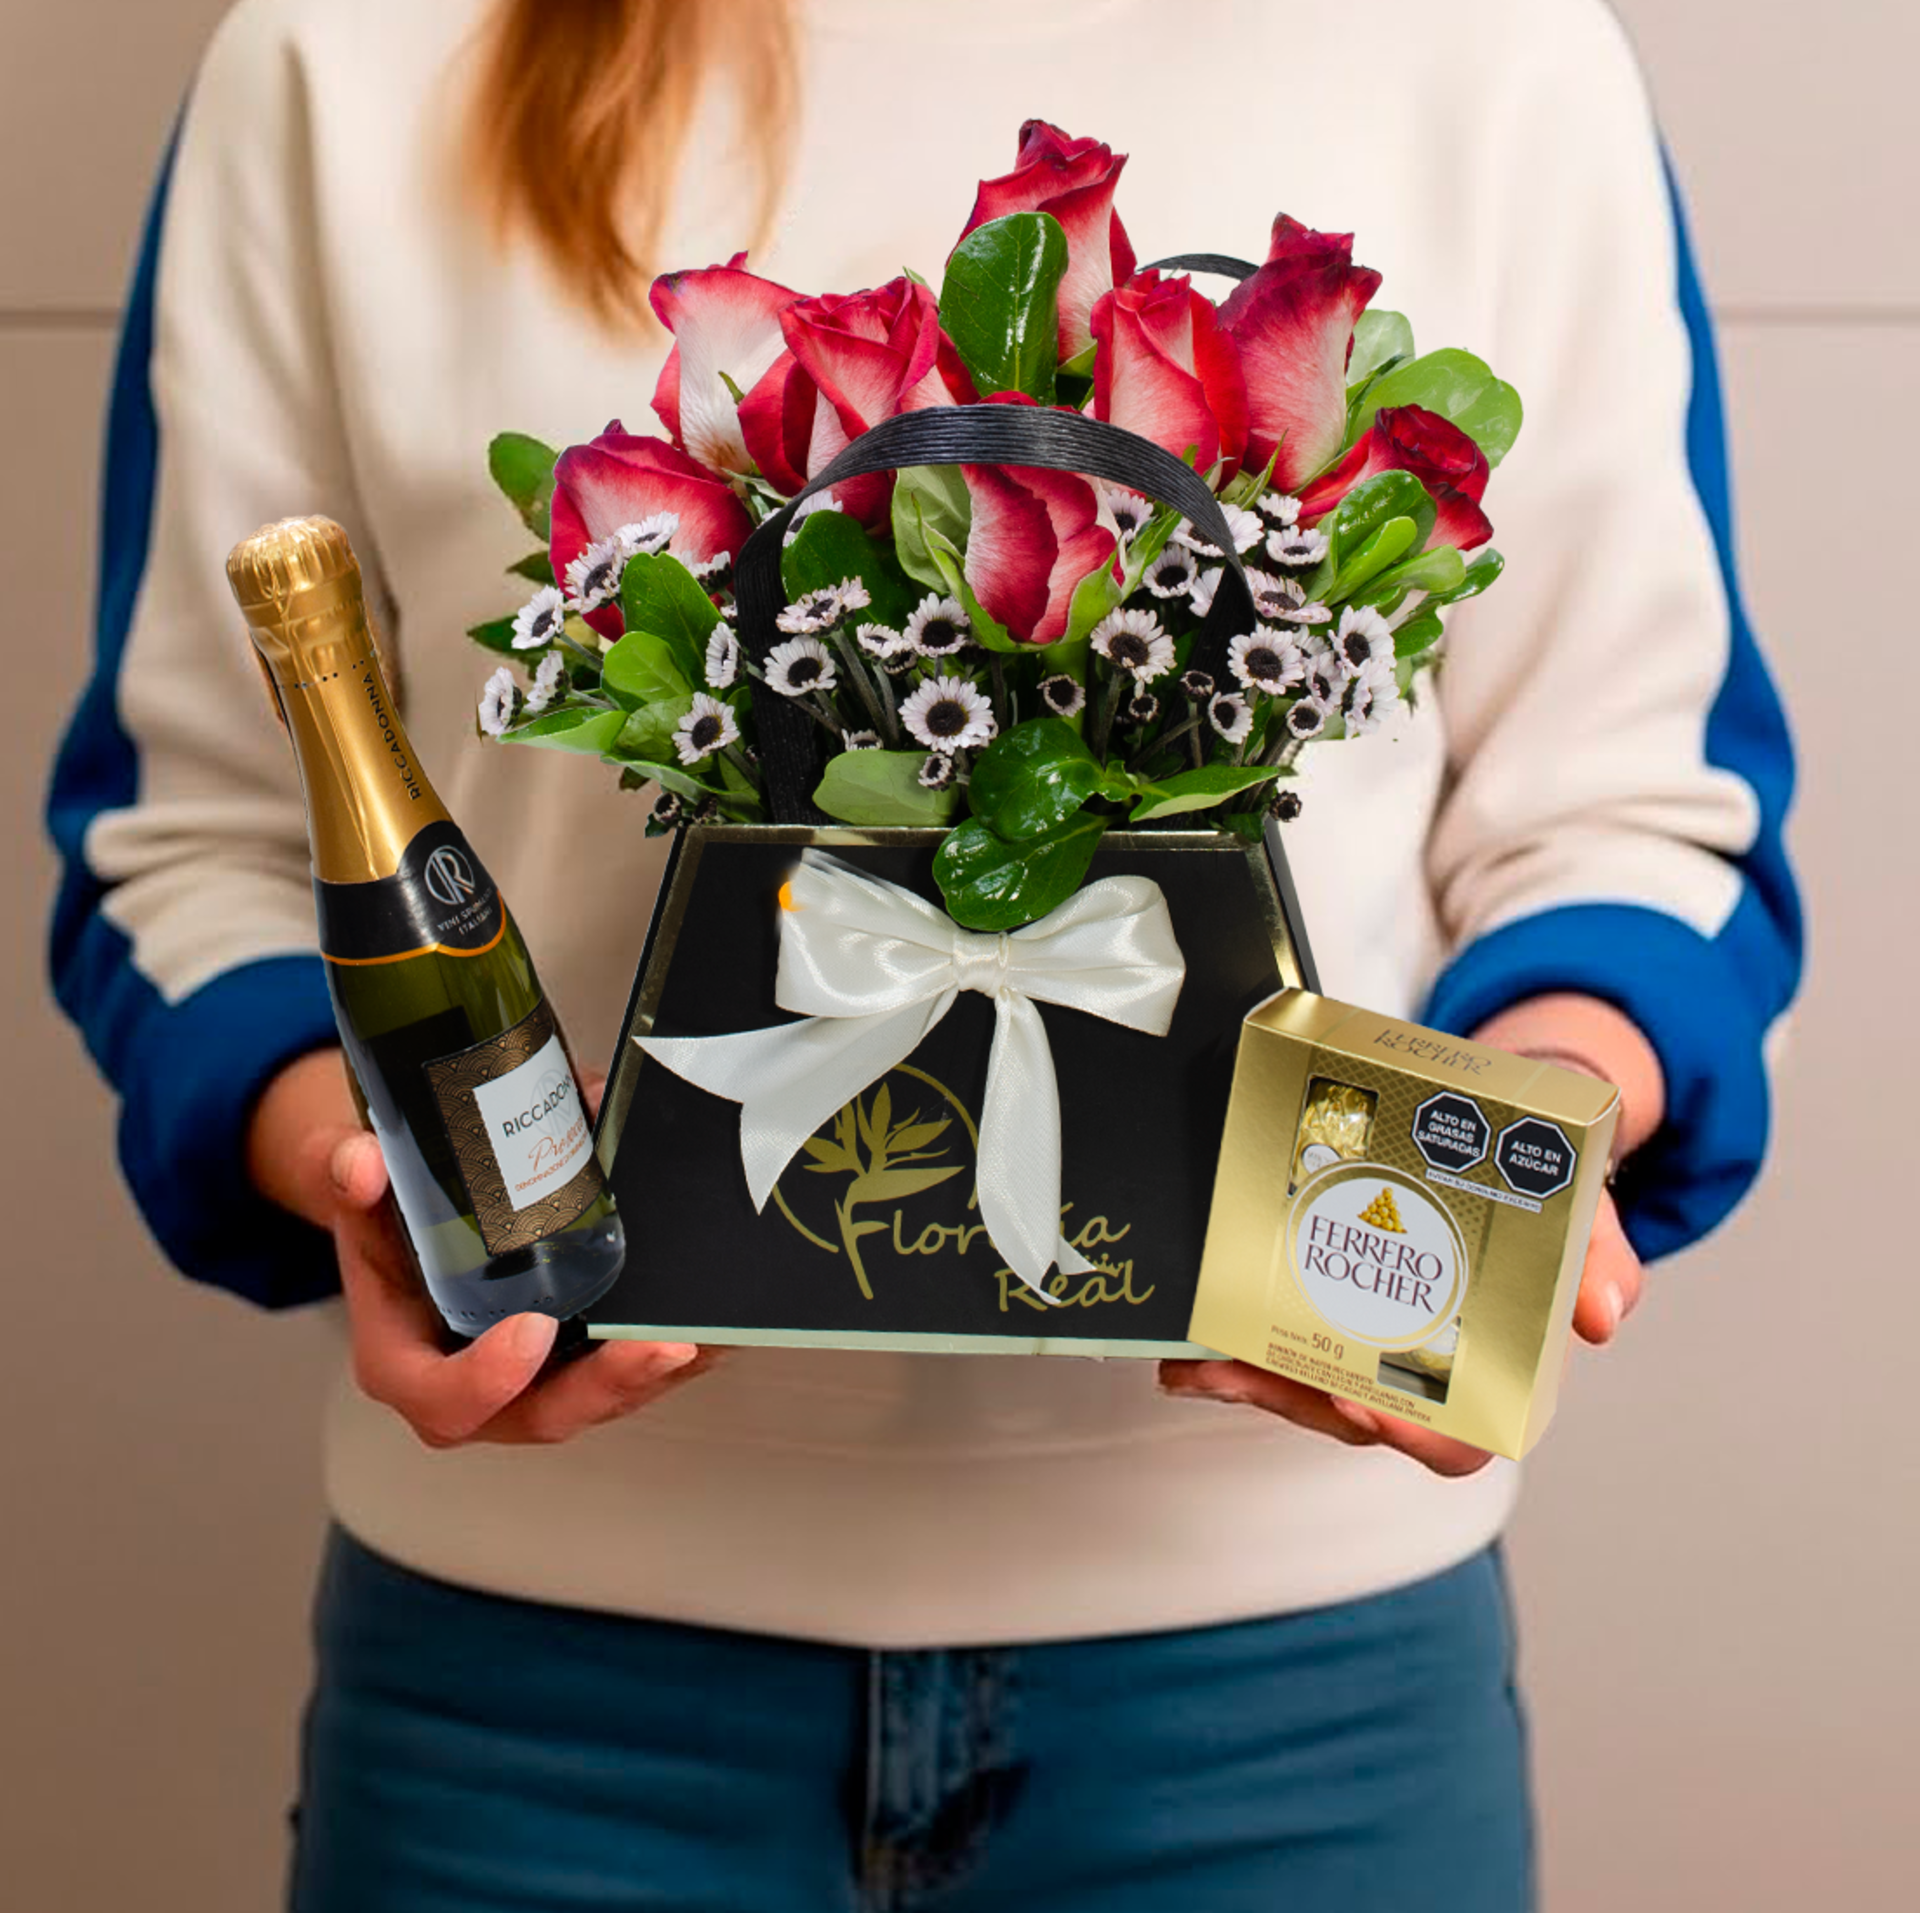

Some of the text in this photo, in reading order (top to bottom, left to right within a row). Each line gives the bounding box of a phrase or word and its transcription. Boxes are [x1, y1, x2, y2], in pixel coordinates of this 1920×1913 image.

[363, 672, 421, 801] RICCADONNA
[1373, 1037, 1482, 1075] ROCHER
[1428, 1121, 1475, 1144] GRASAS
[1430, 1110, 1478, 1133] ALTO EN
[1418, 1130, 1481, 1158] SATURADAS
[1511, 1140, 1562, 1164] ALTO EN
[1509, 1153, 1559, 1177] AZÚCAR
[1310, 1214, 1443, 1281] FERRERO
[993, 1259, 1156, 1312] Real
[1304, 1244, 1435, 1315] ROCHER
[1311, 1333, 1332, 1352] 50
[1333, 1343, 1345, 1360] g
